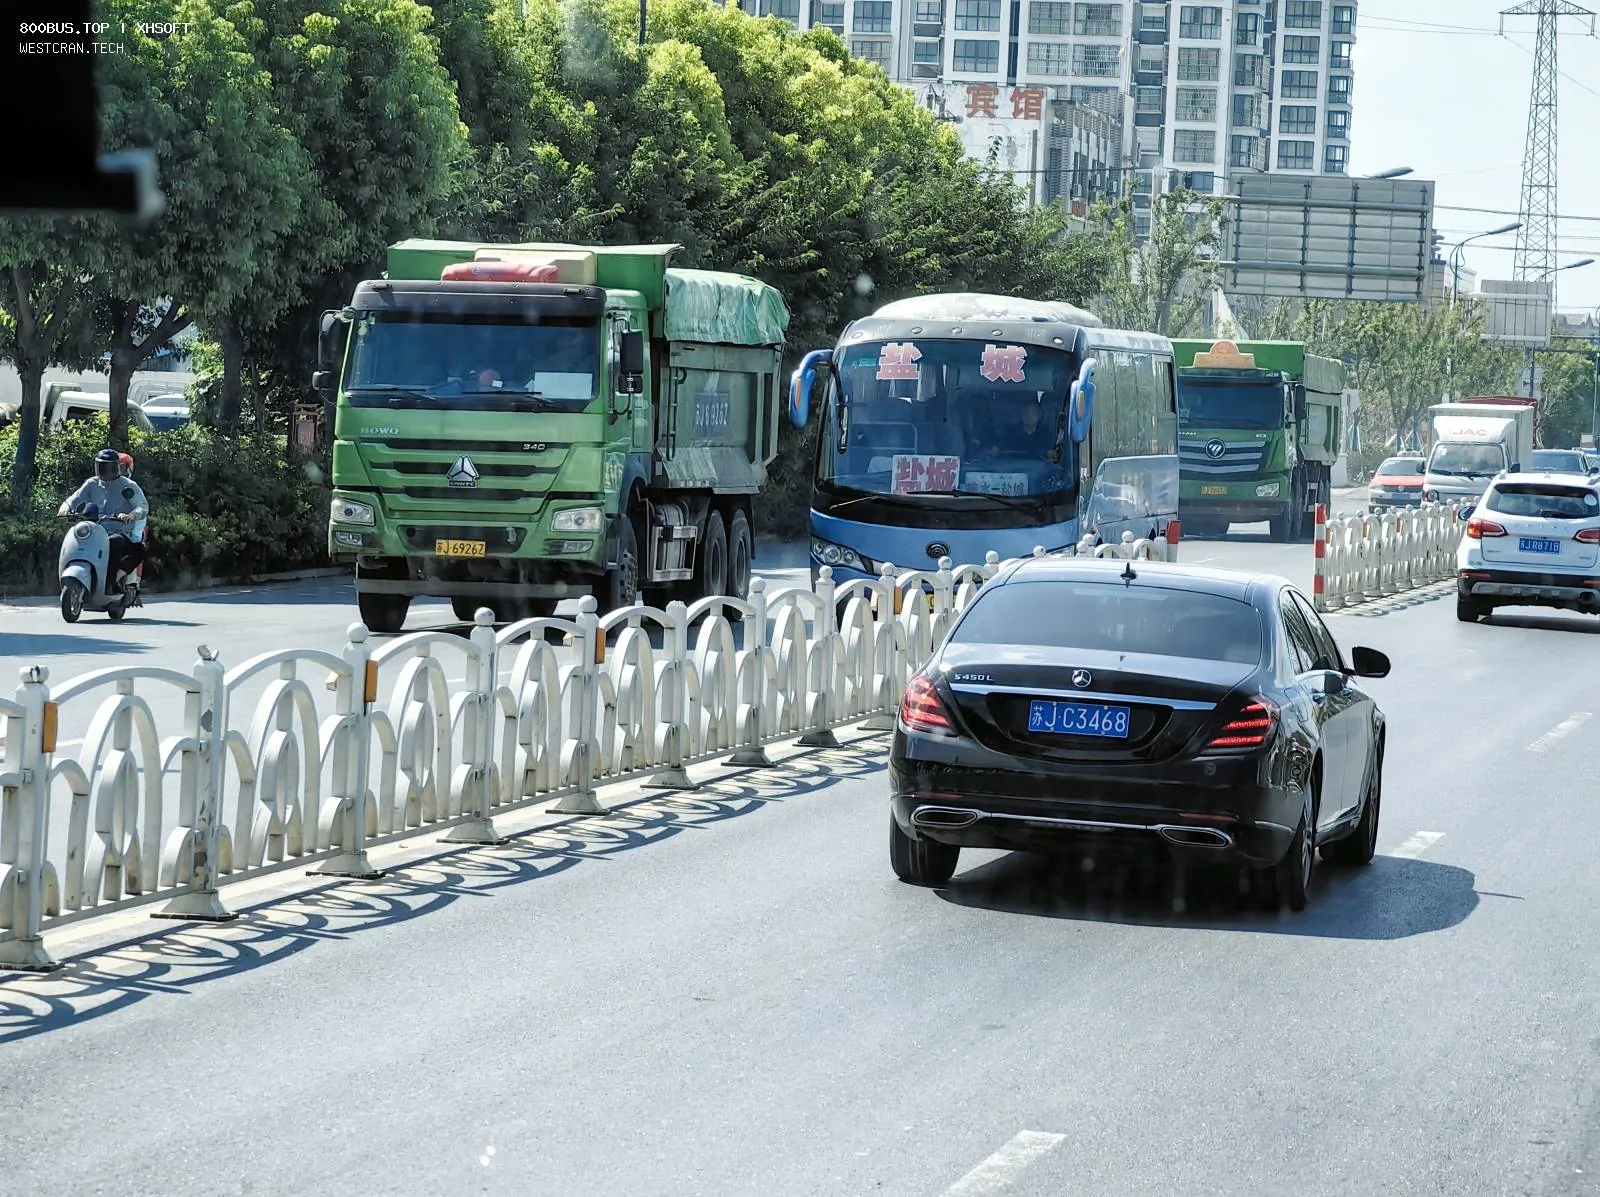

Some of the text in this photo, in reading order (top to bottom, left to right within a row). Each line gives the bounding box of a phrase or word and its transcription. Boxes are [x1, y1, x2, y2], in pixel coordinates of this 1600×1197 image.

[965, 83, 1044, 120] 宾馆
[1452, 428, 1488, 437] JAC
[522, 443, 546, 451] 340
[895, 456, 958, 494] 盐城
